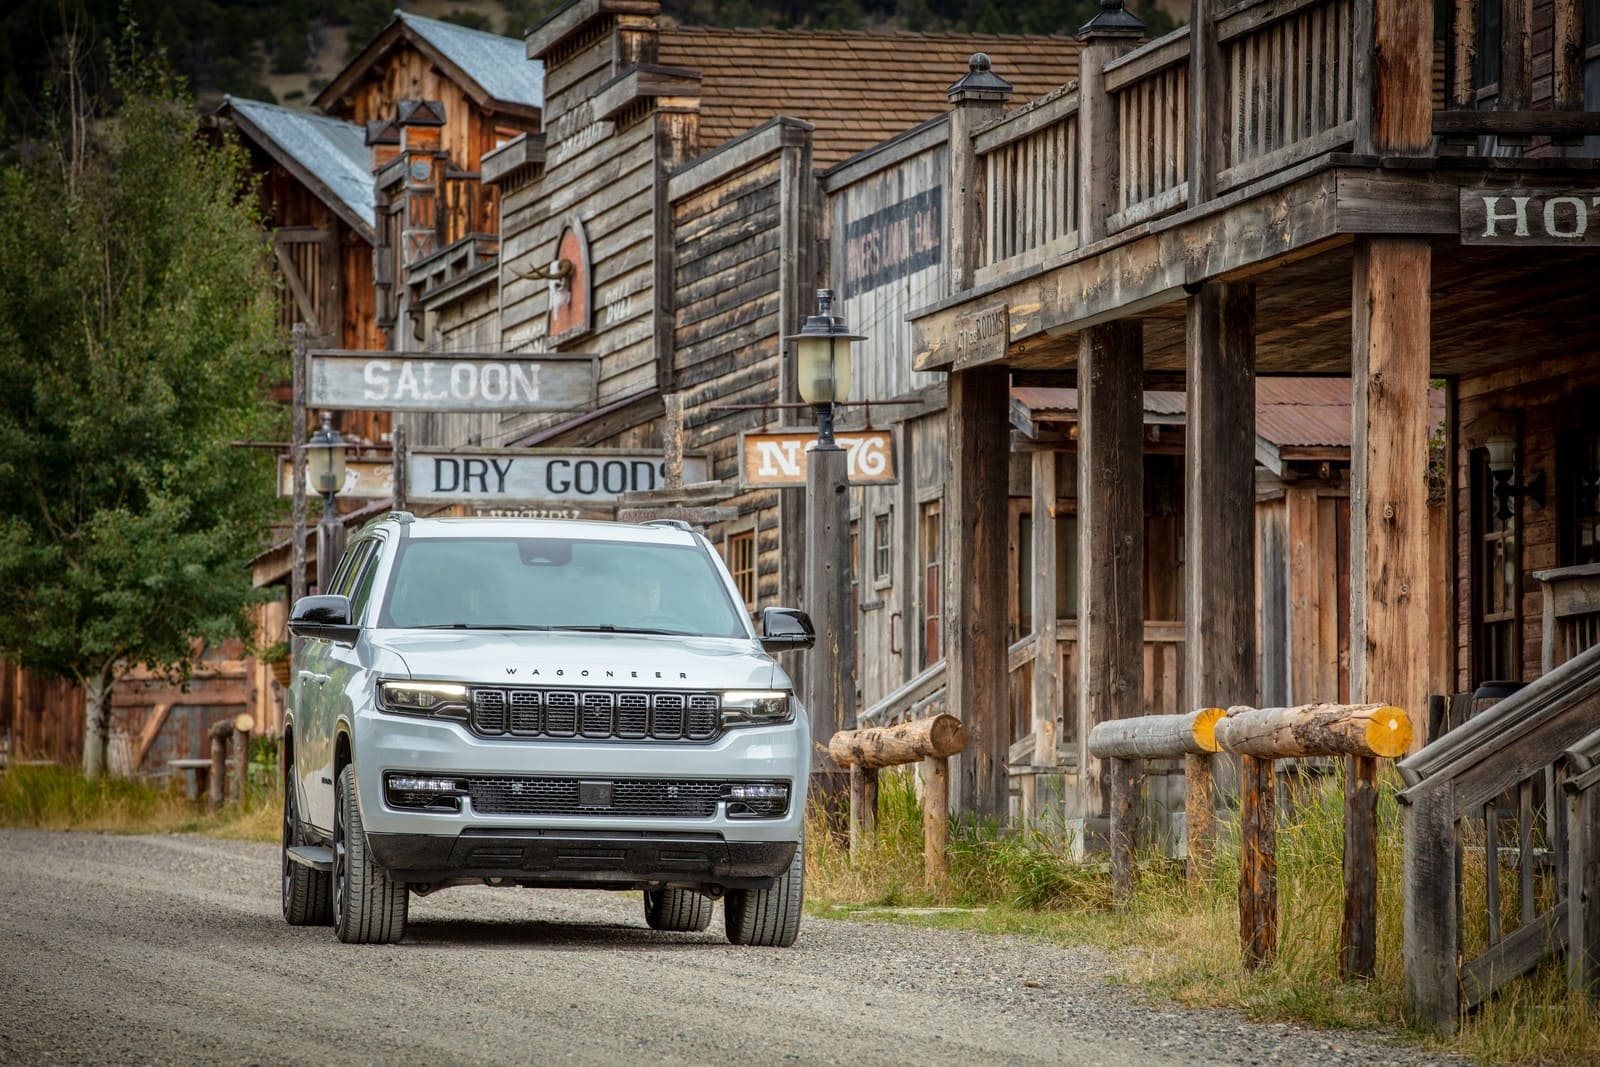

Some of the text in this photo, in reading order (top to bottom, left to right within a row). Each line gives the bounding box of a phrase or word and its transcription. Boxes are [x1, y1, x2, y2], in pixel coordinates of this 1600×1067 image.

[1481, 197, 1600, 238] HO
[976, 311, 1004, 341] ROOMS
[363, 361, 541, 400] SALOON
[432, 458, 514, 493] DRY
[546, 460, 666, 494] GOOD
[756, 440, 818, 476] N
[506, 667, 687, 679] WAGONEER
